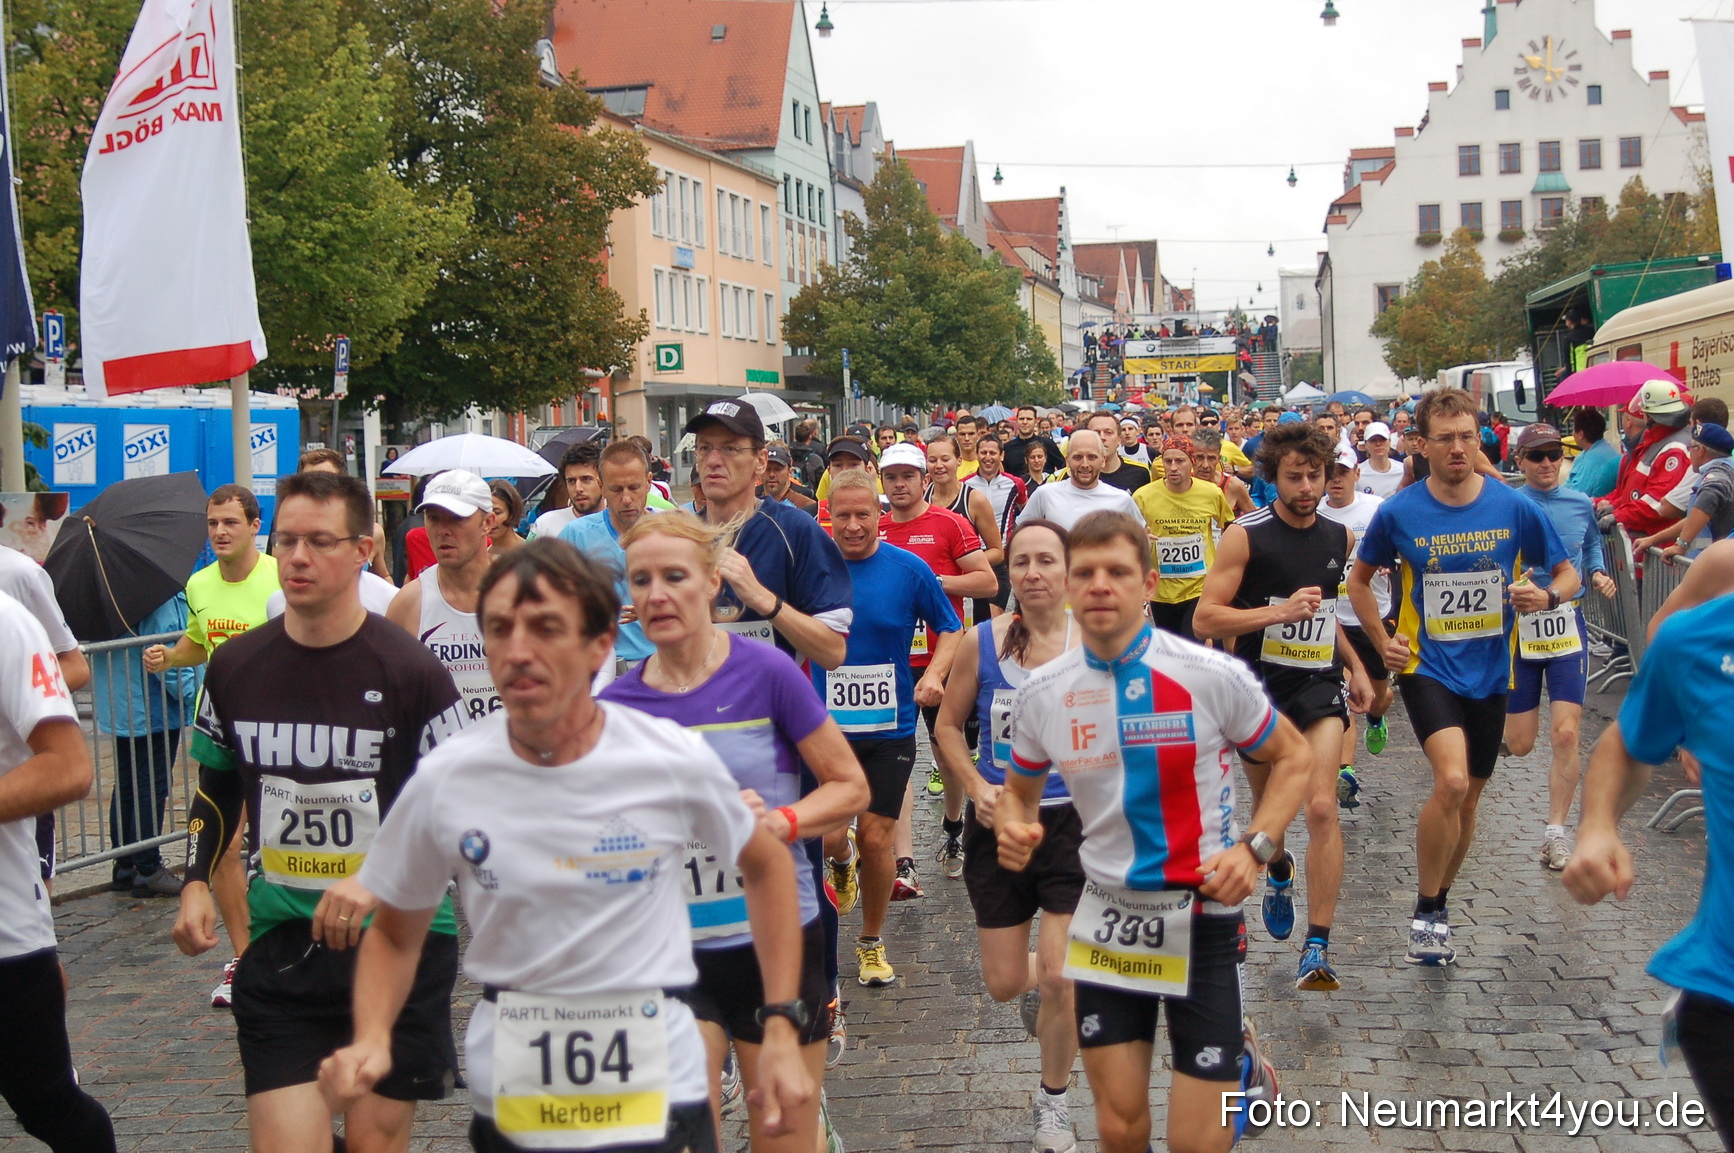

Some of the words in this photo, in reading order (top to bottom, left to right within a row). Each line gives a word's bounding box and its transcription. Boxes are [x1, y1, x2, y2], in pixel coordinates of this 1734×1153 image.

[48, 319, 61, 353] P
[338, 343, 348, 369] P
[659, 347, 679, 367] D
[1160, 359, 1199, 371] START
[1692, 365, 1722, 389] Rotes
[1414, 537, 1429, 548] 10.
[1431, 528, 1511, 546] NEUMARKTER
[1161, 545, 1200, 563] 2260
[1429, 540, 1497, 557] STADTLAUF
[1171, 565, 1194, 573] Roland
[1452, 578, 1489, 587] Neumarkt
[1440, 588, 1488, 615] 242
[207, 618, 250, 631] Müller
[1281, 617, 1326, 642] 507
[1444, 618, 1485, 631] Michael
[1531, 616, 1566, 638] 100
[1280, 645, 1321, 659] Thorsten
[1528, 642, 1549, 651] Franz
[1551, 640, 1572, 650] Xaver
[850, 671, 884, 680] Neumarkt
[833, 681, 890, 707] 3056
[233, 720, 385, 772] THULE
[338, 757, 375, 769] SWEDEN
[1059, 757, 1100, 768] InterFace
[1101, 751, 1117, 761] AG
[295, 793, 354, 805] Neumarkt
[280, 808, 354, 848] 250
[287, 856, 347, 875] Rickard
[1085, 884, 1118, 905] PARTL
[1118, 896, 1173, 911] Neumarkt
[1094, 907, 1165, 949] 399
[1090, 949, 1163, 976] Benjamin
[500, 1006, 551, 1021] PARTL
[554, 1004, 635, 1021] Neumarkt
[528, 1028, 634, 1087] 164
[540, 1101, 622, 1124] Herbert
